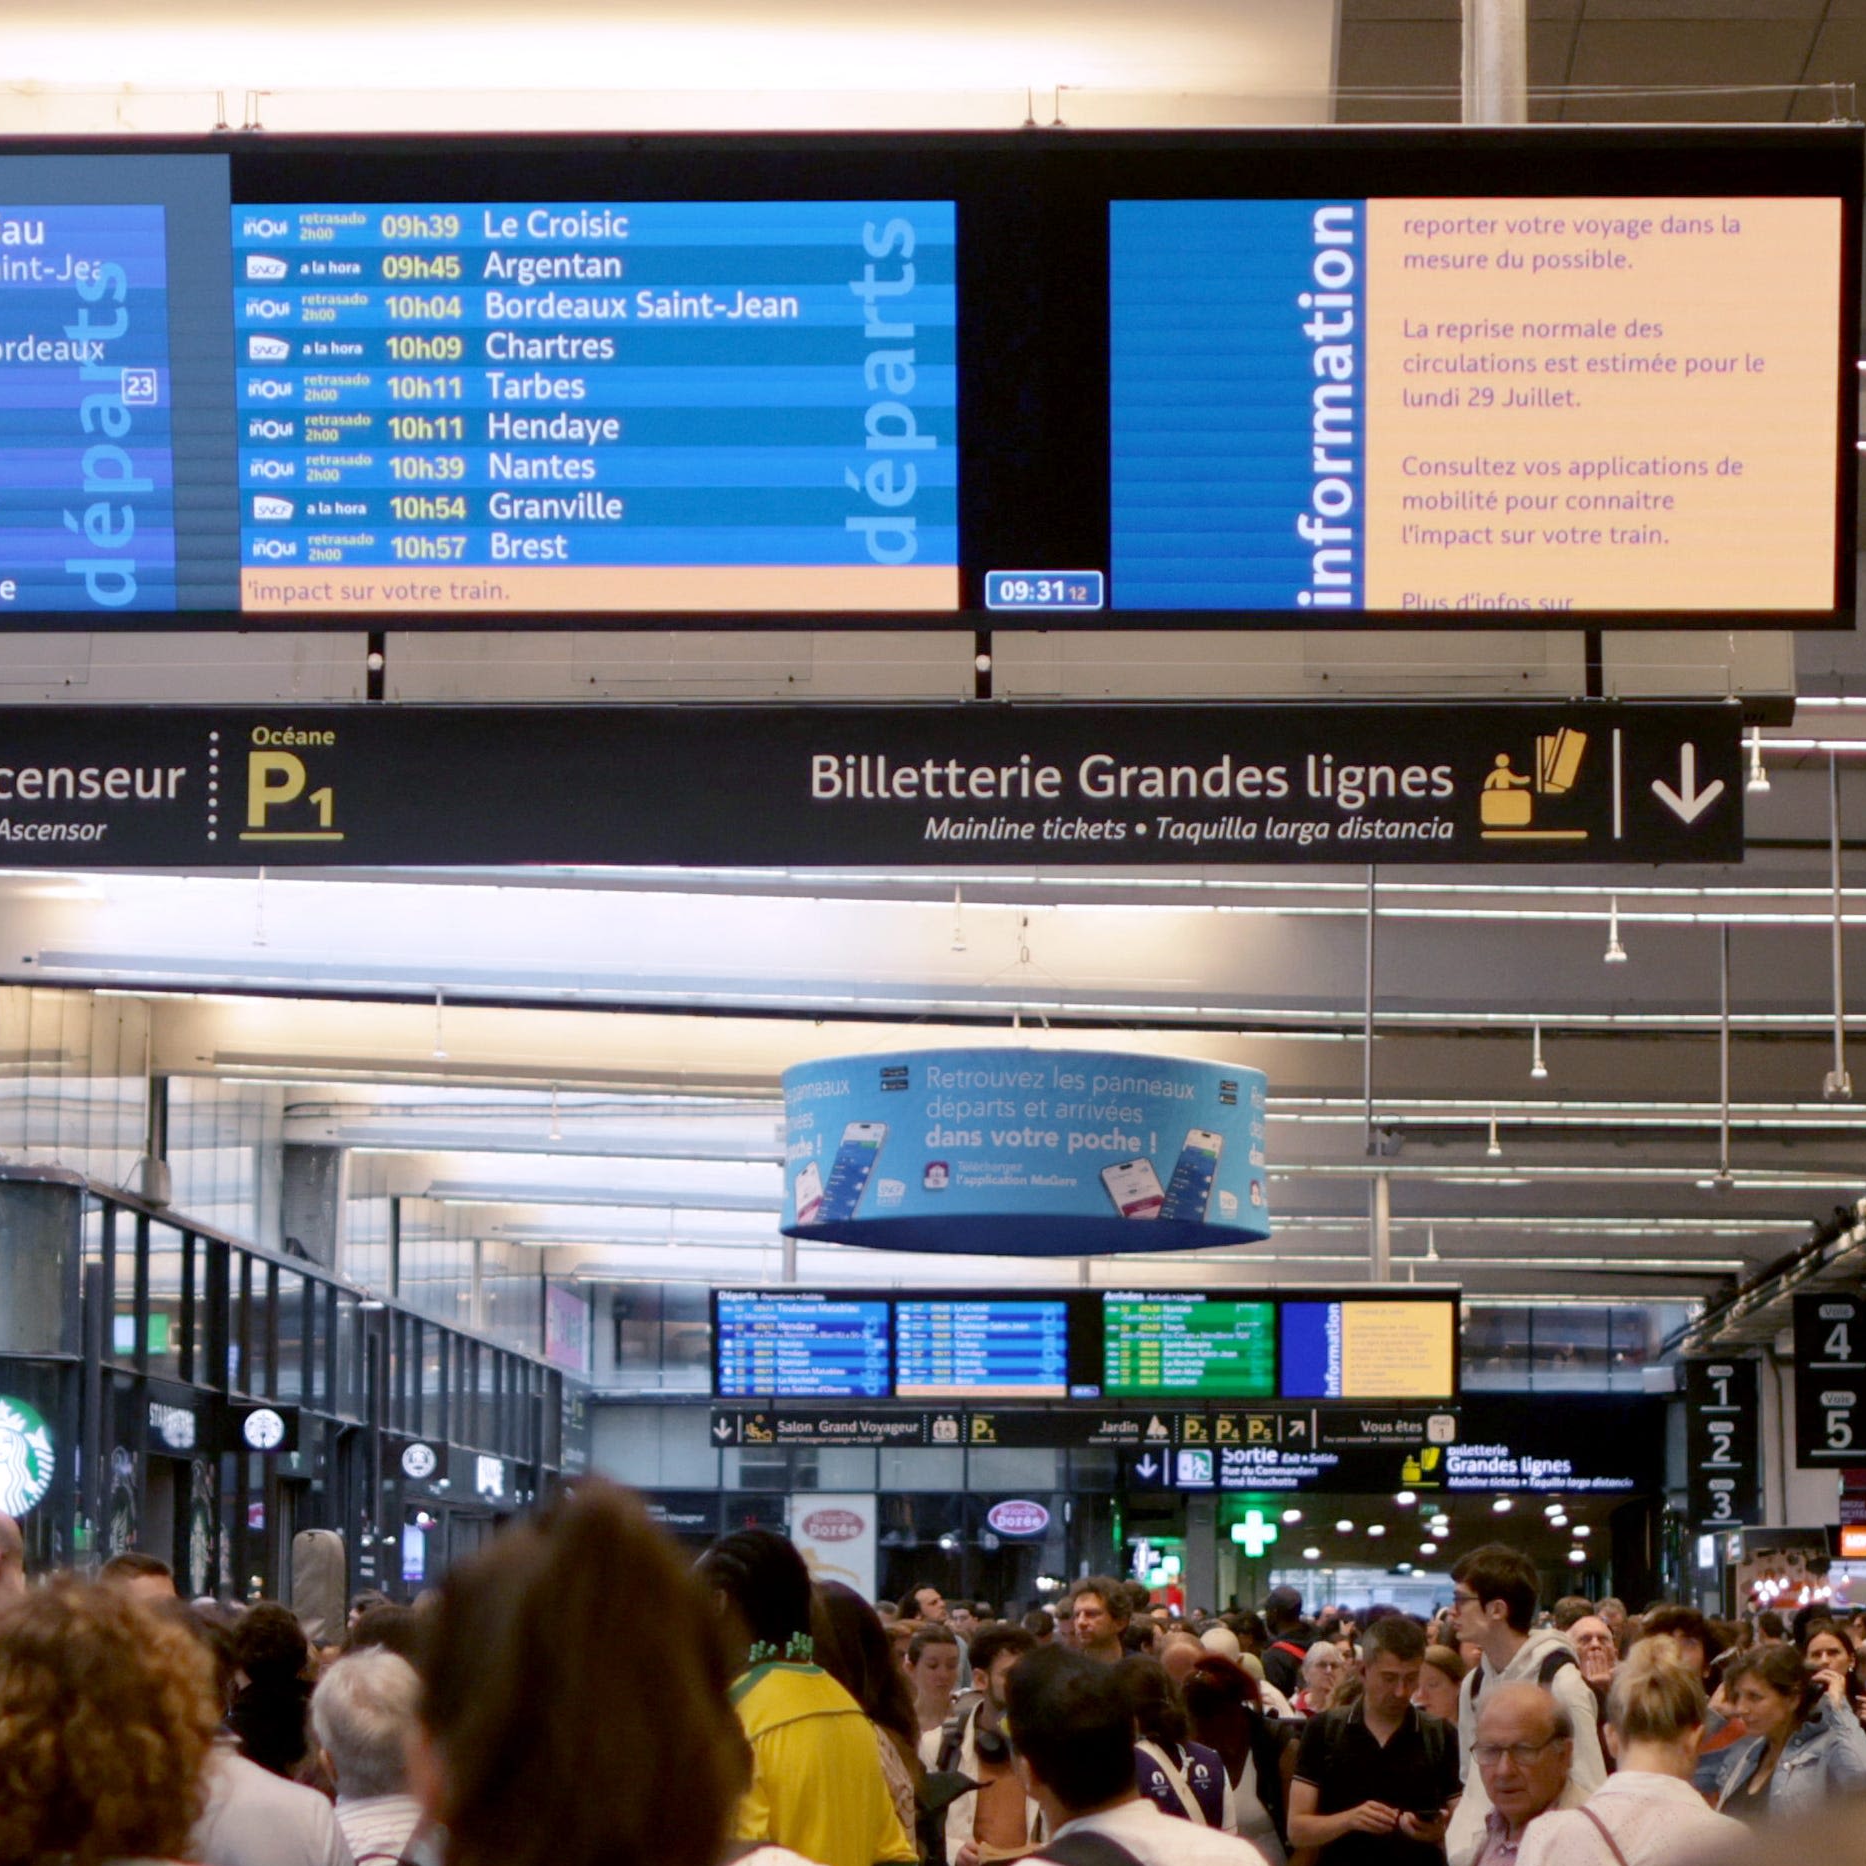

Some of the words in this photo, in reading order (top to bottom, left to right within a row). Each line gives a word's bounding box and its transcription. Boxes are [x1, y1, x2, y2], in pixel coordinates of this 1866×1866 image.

[299, 212, 367, 225] retrasado
[381, 215, 460, 239] 09h39
[484, 210, 518, 239] Le
[527, 209, 629, 239] Croisic
[1403, 217, 1498, 239] reporter
[1505, 218, 1566, 235] votre
[1573, 219, 1653, 239] voyage
[1661, 215, 1714, 235] dans
[1721, 214, 1741, 235] la
[300, 227, 334, 241] 2h00
[300, 265, 309, 275] a
[312, 262, 326, 275] la
[329, 262, 361, 275] hora
[382, 255, 462, 279] 09h45
[484, 251, 622, 286] Argentan
[1403, 253, 1489, 269] mesure
[1496, 249, 1524, 269] du
[1533, 248, 1633, 274] possible.
[386, 296, 462, 320] 10h04
[485, 291, 628, 320] Bordeaux
[636, 290, 799, 320] Saint-Jean
[1403, 319, 1428, 338] La
[1436, 319, 1514, 343] reprise
[1522, 318, 1617, 338] normale
[1624, 318, 1663, 338] des
[386, 337, 462, 360] 10h09
[485, 332, 615, 360] Chartres
[1403, 353, 1536, 373] circulations
[1544, 355, 1579, 373] est
[1586, 353, 1677, 373] estimée
[1685, 356, 1737, 377] pour
[1745, 353, 1765, 373] le
[126, 377, 153, 396] 23
[486, 372, 586, 400] Tarbes
[845, 218, 937, 566] départs
[1403, 387, 1460, 407] lundi
[1468, 387, 1494, 407] 29
[1501, 387, 1581, 407] Juillet.
[1297, 205, 1354, 609] information
[64, 262, 154, 607] départs
[488, 413, 621, 446] Hendaye
[489, 452, 597, 480] Nantes
[1402, 456, 1516, 476] Consultez
[1523, 461, 1561, 476] vos
[1568, 456, 1709, 480] applications
[1716, 455, 1744, 476] de
[489, 492, 623, 520] Granville
[491, 532, 569, 560] Brest
[1000, 581, 1065, 601] 09:31
[1069, 587, 1087, 600] 12
[251, 725, 336, 747] Océane
[810, 754, 1063, 800] Billetterie
[1078, 754, 1289, 800] Grandes
[1306, 754, 1454, 810] lignes
[924, 816, 1035, 841] Mainline
[1042, 816, 1128, 841] tickets
[1155, 816, 1257, 845] Taquilla
[1262, 816, 1331, 846] larga
[1337, 816, 1454, 841] distancia
[926, 1066, 1044, 1090] Retrouvez
[1053, 1066, 1085, 1091] les
[1093, 1074, 1195, 1099] panneaux
[925, 1095, 1016, 1123] départs
[1024, 1101, 1048, 1119] et
[1055, 1100, 1143, 1124] arrivées
[925, 1124, 983, 1148] dans
[991, 1128, 1059, 1148] votre
[1068, 1127, 1142, 1155] poche
[1150, 1132, 1157, 1154] !
[1824, 1323, 1852, 1361] 4
[1713, 1379, 1728, 1405] 1
[777, 1420, 813, 1433] Salon
[819, 1420, 857, 1433] Grand
[860, 1420, 918, 1437] Voyageur
[1099, 1420, 1139, 1433] Jardin
[1361, 1420, 1393, 1433] Vous
[1395, 1419, 1423, 1433] êtes
[1827, 1410, 1852, 1449] 5
[1222, 1447, 1279, 1463] Sortie
[1712, 1435, 1731, 1462] 2
[1447, 1457, 1517, 1474] Grandes
[1521, 1457, 1571, 1476] lignes
[1713, 1491, 1732, 1519] 3
[997, 1515, 1040, 1528] Dorée
